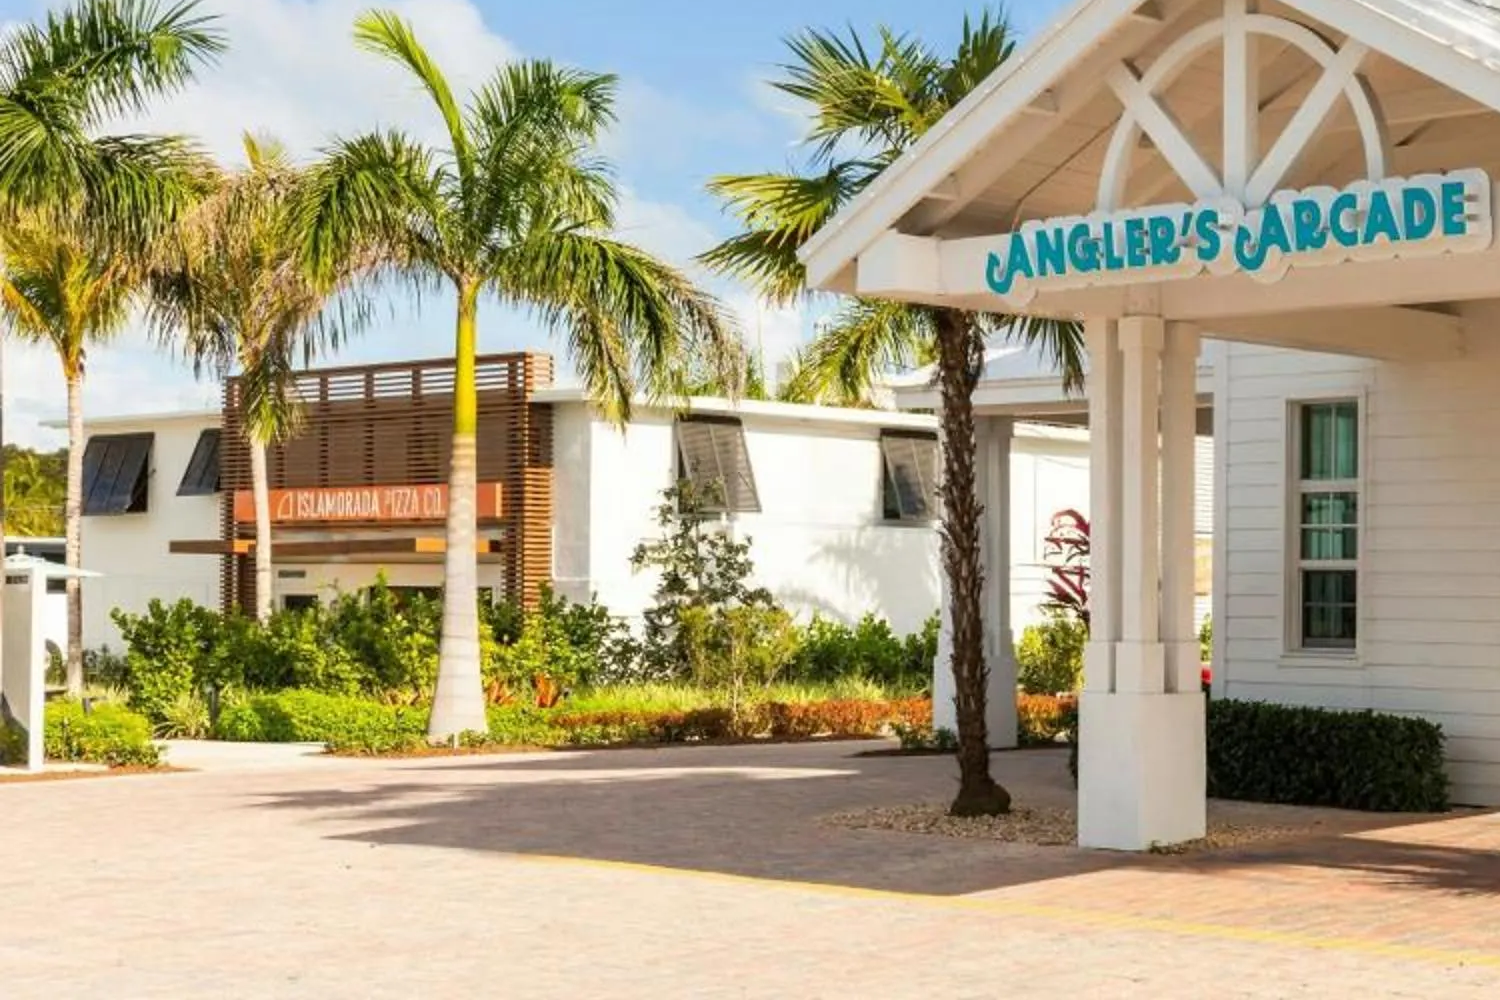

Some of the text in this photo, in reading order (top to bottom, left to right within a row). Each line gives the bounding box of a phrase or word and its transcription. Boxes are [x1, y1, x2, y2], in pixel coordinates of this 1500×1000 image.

[986, 182, 1466, 294] ANGLER'S ARCADE
[298, 489, 379, 518] ISLAMORADA
